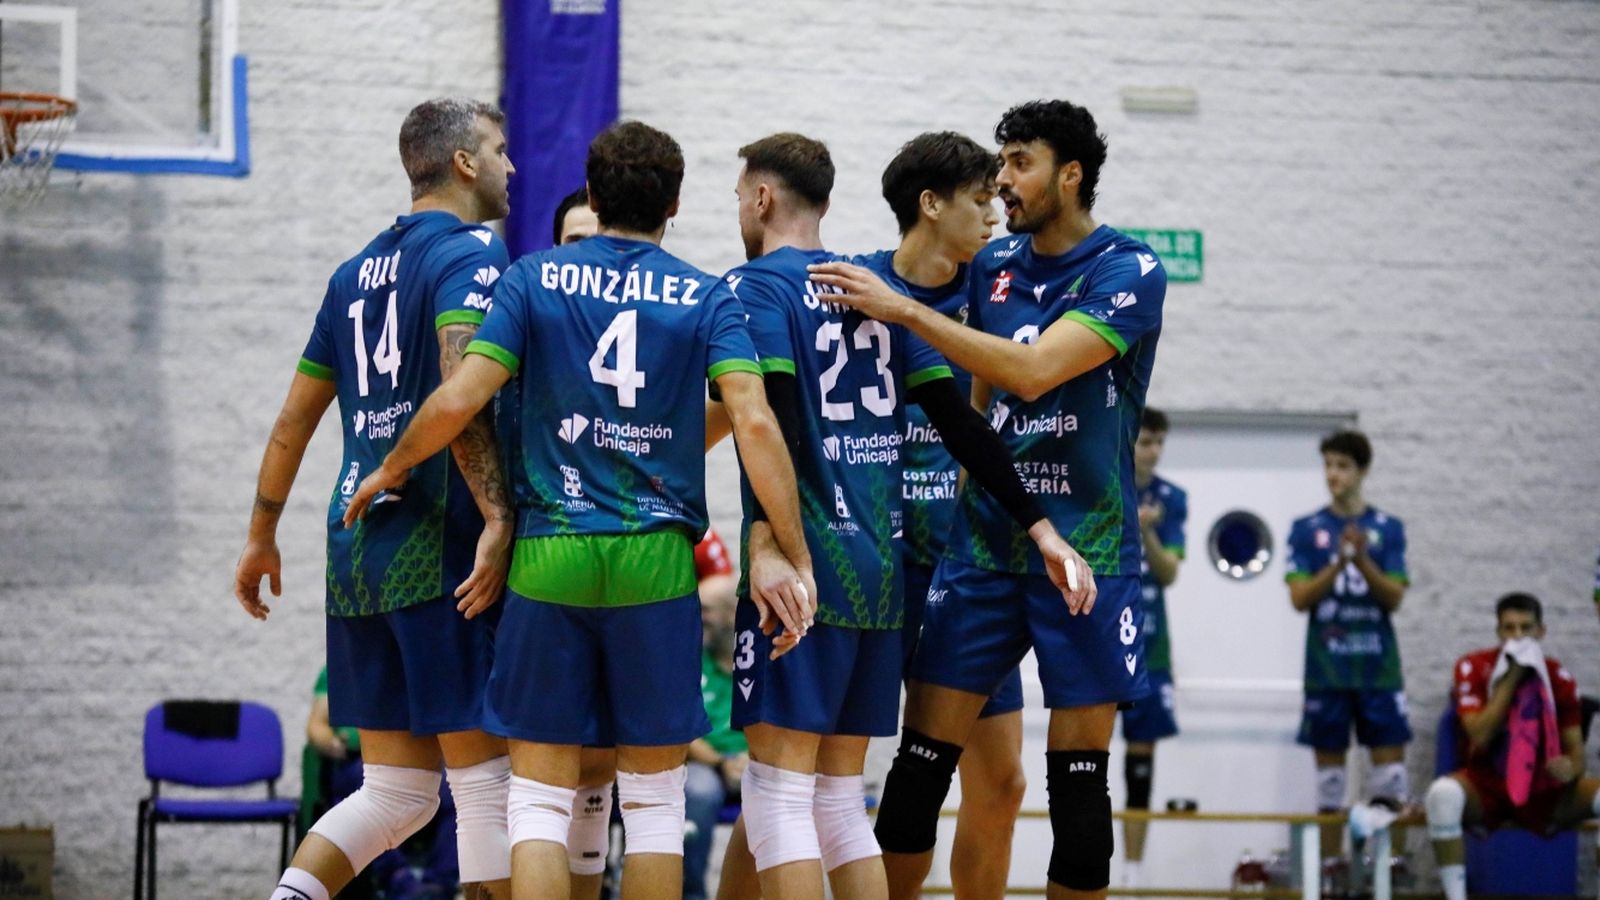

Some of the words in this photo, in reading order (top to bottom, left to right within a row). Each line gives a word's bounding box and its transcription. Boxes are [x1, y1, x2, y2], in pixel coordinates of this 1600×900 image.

[541, 262, 700, 306] GONZÁLEZ
[348, 290, 401, 397] 14
[588, 309, 646, 408] 4
[815, 319, 897, 421] 23
[593, 418, 673, 440] Fundación
[1013, 410, 1078, 438] Unicaja
[594, 434, 650, 456] Unicaja
[846, 449, 899, 466] Unicaja
[1052, 463, 1069, 476] DE
[903, 481, 955, 500] LMERÍA
[1029, 475, 1072, 495] ERÍA
[1119, 606, 1137, 645] 8
[733, 630, 754, 670] 3
